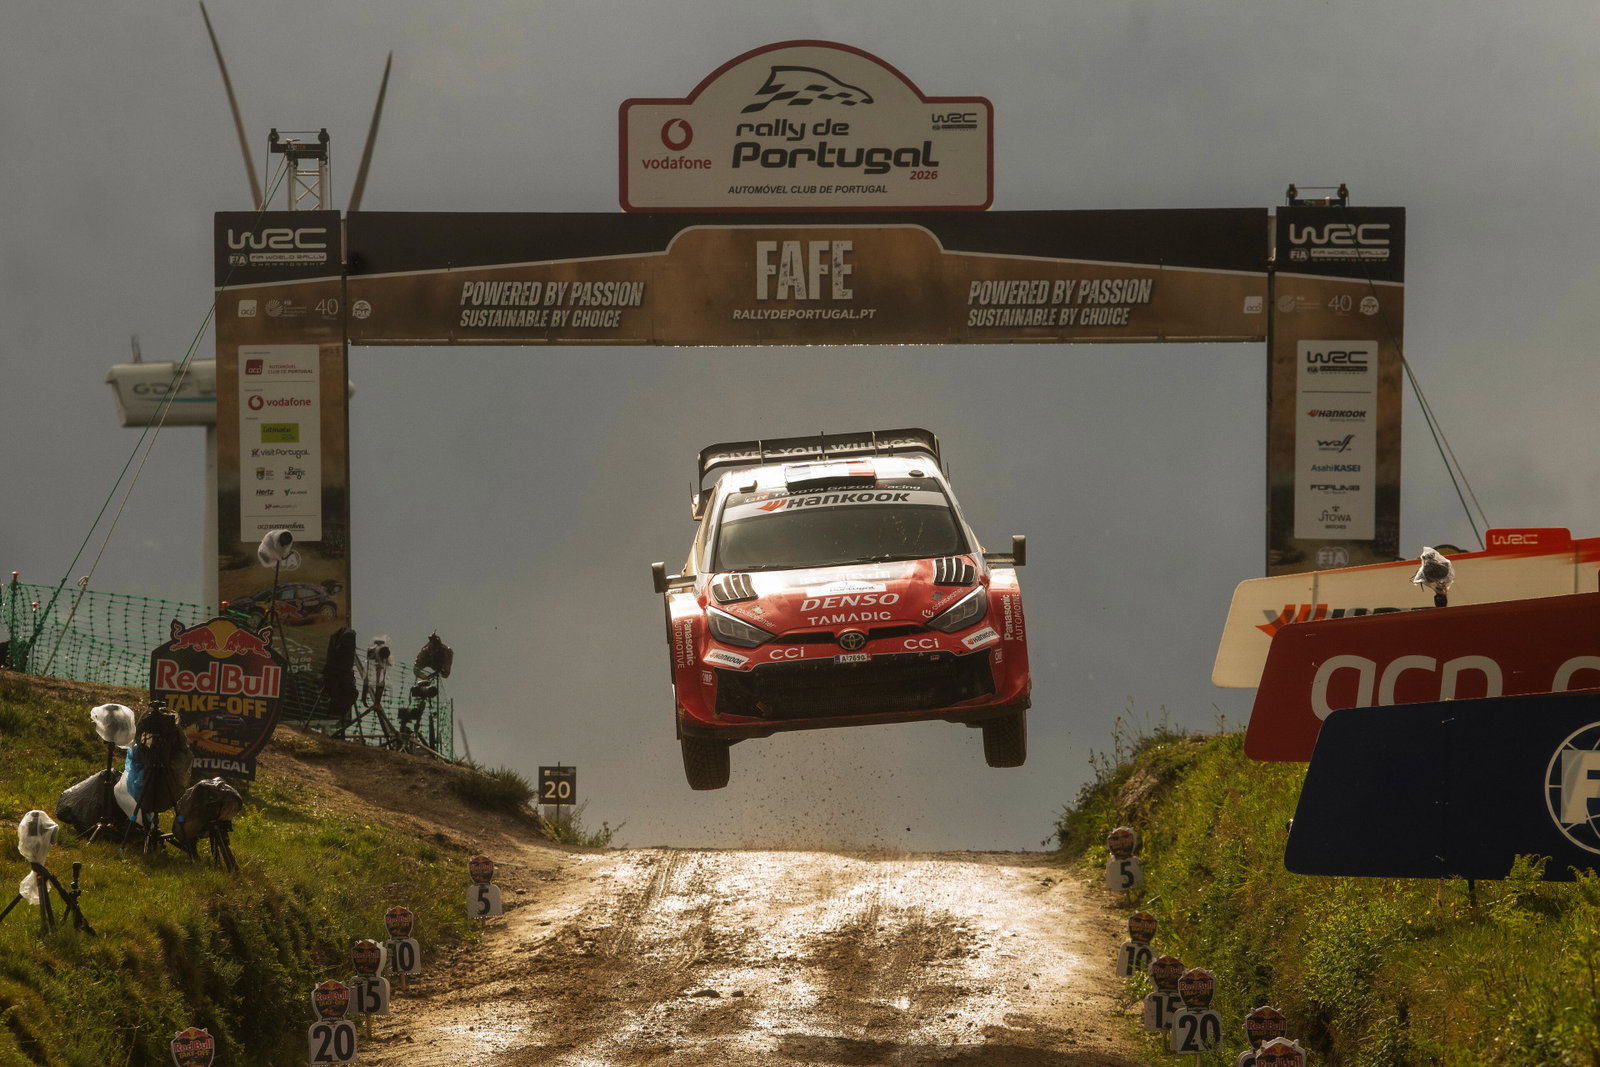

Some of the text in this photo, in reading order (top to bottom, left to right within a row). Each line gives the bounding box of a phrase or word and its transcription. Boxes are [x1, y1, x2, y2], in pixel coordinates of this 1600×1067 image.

[932, 113, 977, 123] WRC
[736, 119, 850, 141] rally de
[642, 156, 712, 169] vodafone
[732, 141, 939, 175] Portugal
[910, 171, 938, 180] 2026
[728, 183, 888, 194] AUTOMÓVEL CLUB DE PORTUGAL
[228, 228, 327, 249] WRC
[1290, 223, 1390, 244] WRC
[1291, 250, 1308, 259] FIA
[756, 240, 853, 300] FAFE
[460, 281, 645, 306] POWERED BY PASSION
[967, 279, 1153, 305] POWERED BY PASSION
[315, 299, 339, 315] 40
[1328, 295, 1352, 311] 40
[459, 309, 622, 328] SUSTAINABLE BY CHOICE
[732, 309, 877, 320] RALLYDEPORTUGAL.PT
[967, 308, 1130, 327] SUSTAINABLE BY CHOICE
[1307, 351, 1368, 363] WRC
[266, 397, 312, 406] vodafone
[1492, 534, 1538, 545] WRC
[1317, 551, 1346, 565] FIA
[800, 593, 900, 611] DENSO
[807, 611, 891, 626] TAMADIC
[1003, 594, 1014, 640] Panasonic
[684, 618, 696, 666] Panasonic
[155, 659, 219, 694] Red
[220, 663, 281, 698] Bull
[165, 694, 268, 719] TAKE-OFF
[193, 758, 249, 773] RTUGAL
[545, 781, 570, 798] 20
[1120, 862, 1134, 889] 5
[477, 887, 490, 915] 5
[388, 942, 414, 972] 10
[357, 981, 381, 1013] 15
[1179, 1014, 1220, 1051] 20
[313, 1024, 354, 1062] 20
